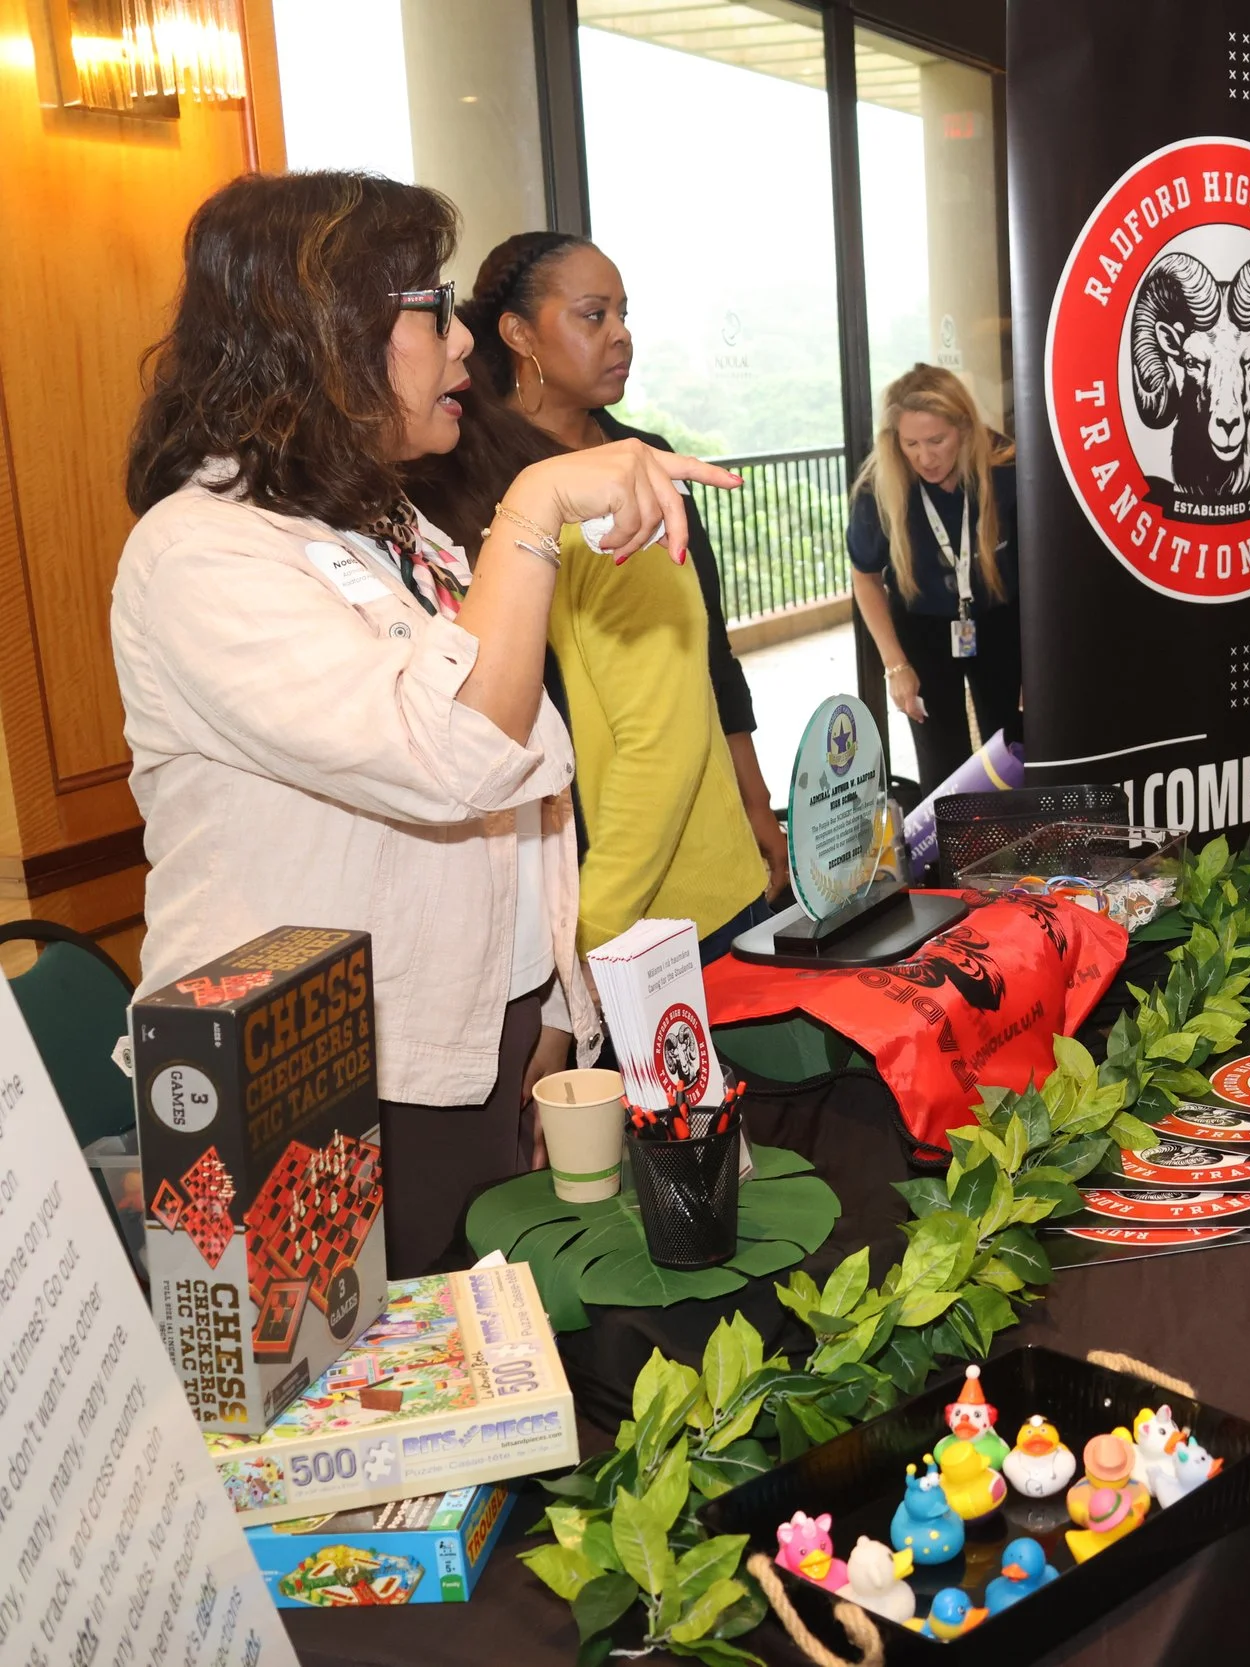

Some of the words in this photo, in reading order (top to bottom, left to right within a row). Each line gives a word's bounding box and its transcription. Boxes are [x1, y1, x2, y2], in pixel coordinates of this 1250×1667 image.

[1084, 176, 1190, 306] RADFORD
[1174, 499, 1245, 516] ESTABLISHED
[809, 790, 830, 806] ADMIRAL
[832, 782, 849, 796] ARTHUR
[857, 770, 875, 785] RADFORD
[828, 851, 851, 869] DECEMBER
[266, 933, 351, 972] CHESS
[245, 948, 367, 1073] CHESS
[656, 1017, 670, 1054] RADFORD
[669, 1008, 681, 1020] HIGH
[682, 1009, 698, 1029] SCHOOL
[1031, 1000, 1045, 1025] HI
[246, 1017, 353, 1114] CHECKERS
[358, 1009, 369, 1038] &
[700, 1041, 708, 1088] CENTER
[170, 1070, 186, 1126] GAMES
[191, 1093, 209, 1105] 3
[249, 1101, 283, 1151] TIC
[288, 1068, 328, 1120] TAC
[332, 1042, 371, 1088] TOE
[1224, 1073, 1250, 1099] RADFORD
[24, 1220, 42, 1254] on
[37, 1179, 62, 1239] your
[11, 1295, 48, 1376] times?
[42, 1273, 62, 1308] Go
[59, 1239, 80, 1281] out
[176, 1279, 193, 1319] TIC
[330, 1293, 358, 1328] GAMES
[338, 1277, 346, 1299] 3
[179, 1325, 198, 1372] TAC
[193, 1280, 217, 1405] CHECKERS
[210, 1283, 249, 1424] CHESS
[8, 1420, 43, 1492] don't
[36, 1365, 66, 1429] want
[58, 1333, 80, 1376] the
[75, 1282, 102, 1341] other
[491, 1360, 540, 1397] 500
[203, 1410, 218, 1423] &
[402, 1429, 458, 1458] BITS
[480, 1411, 562, 1443] PIECES
[17, 1503, 57, 1585] many,
[49, 1434, 85, 1507] many,
[77, 1371, 108, 1440] many
[100, 1324, 129, 1382] more.
[501, 1432, 564, 1449] bitsandpieces.com
[290, 1447, 358, 1488] 500
[405, 1464, 444, 1478] Puzzle
[39, 1567, 78, 1644] track,
[69, 1507, 93, 1570] and
[87, 1454, 115, 1521] cross
[109, 1377, 147, 1462] country.
[87, 1593, 107, 1626] in
[99, 1549, 121, 1598] the
[115, 1464, 147, 1556] action?
[141, 1425, 164, 1477] Join
[111, 1625, 137, 1667] any
[128, 1561, 155, 1632] clubs.
[148, 1523, 167, 1562] No
[161, 1480, 179, 1527] one
[171, 1461, 187, 1486] is
[441, 1580, 461, 1589] Family
[168, 1580, 184, 1616] at
